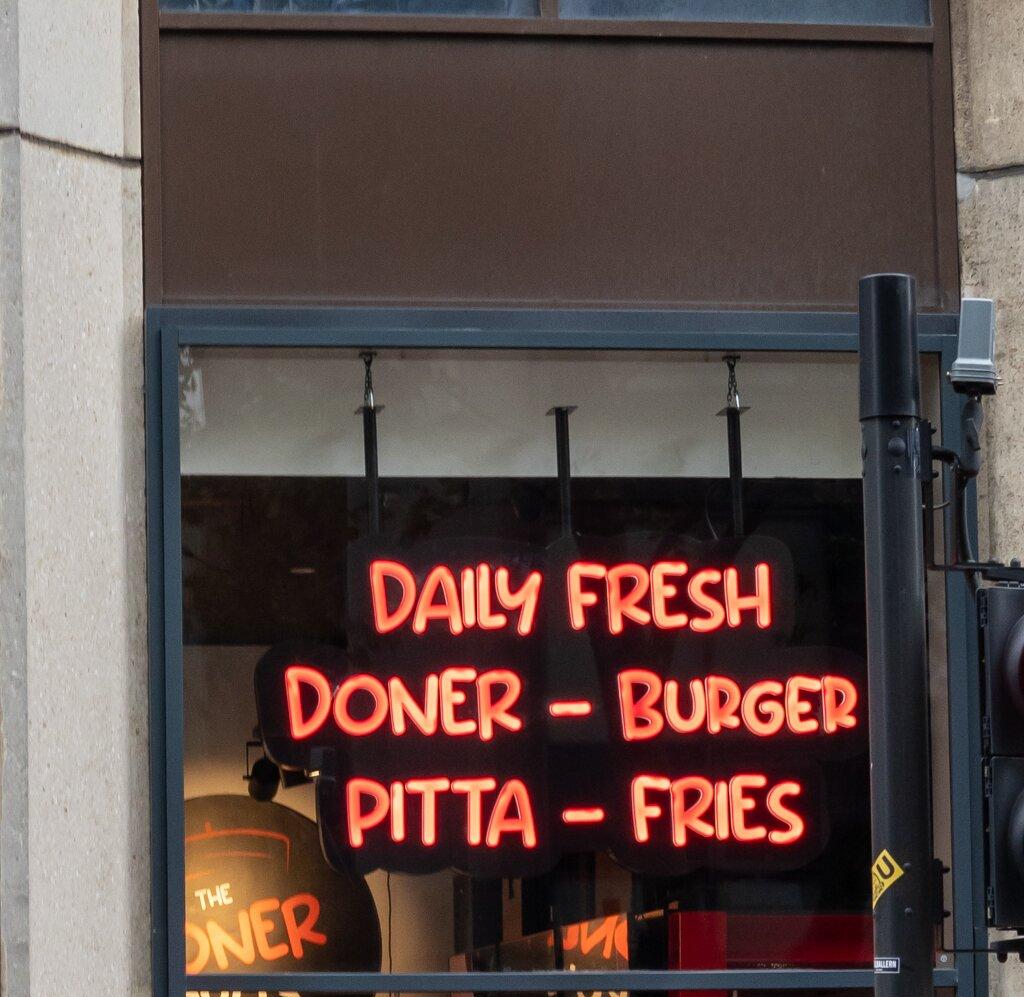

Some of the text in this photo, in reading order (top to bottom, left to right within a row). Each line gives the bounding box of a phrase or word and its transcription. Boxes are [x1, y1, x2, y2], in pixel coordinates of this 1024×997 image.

[369, 560, 772, 636] DAILY FRESH
[284, 666, 523, 742] DONER
[617, 669, 858, 742] BURGER
[346, 777, 538, 848] PITTA
[631, 774, 805, 847] FRIES
[185, 893, 328, 975] ONER
[194, 882, 234, 912] THE
